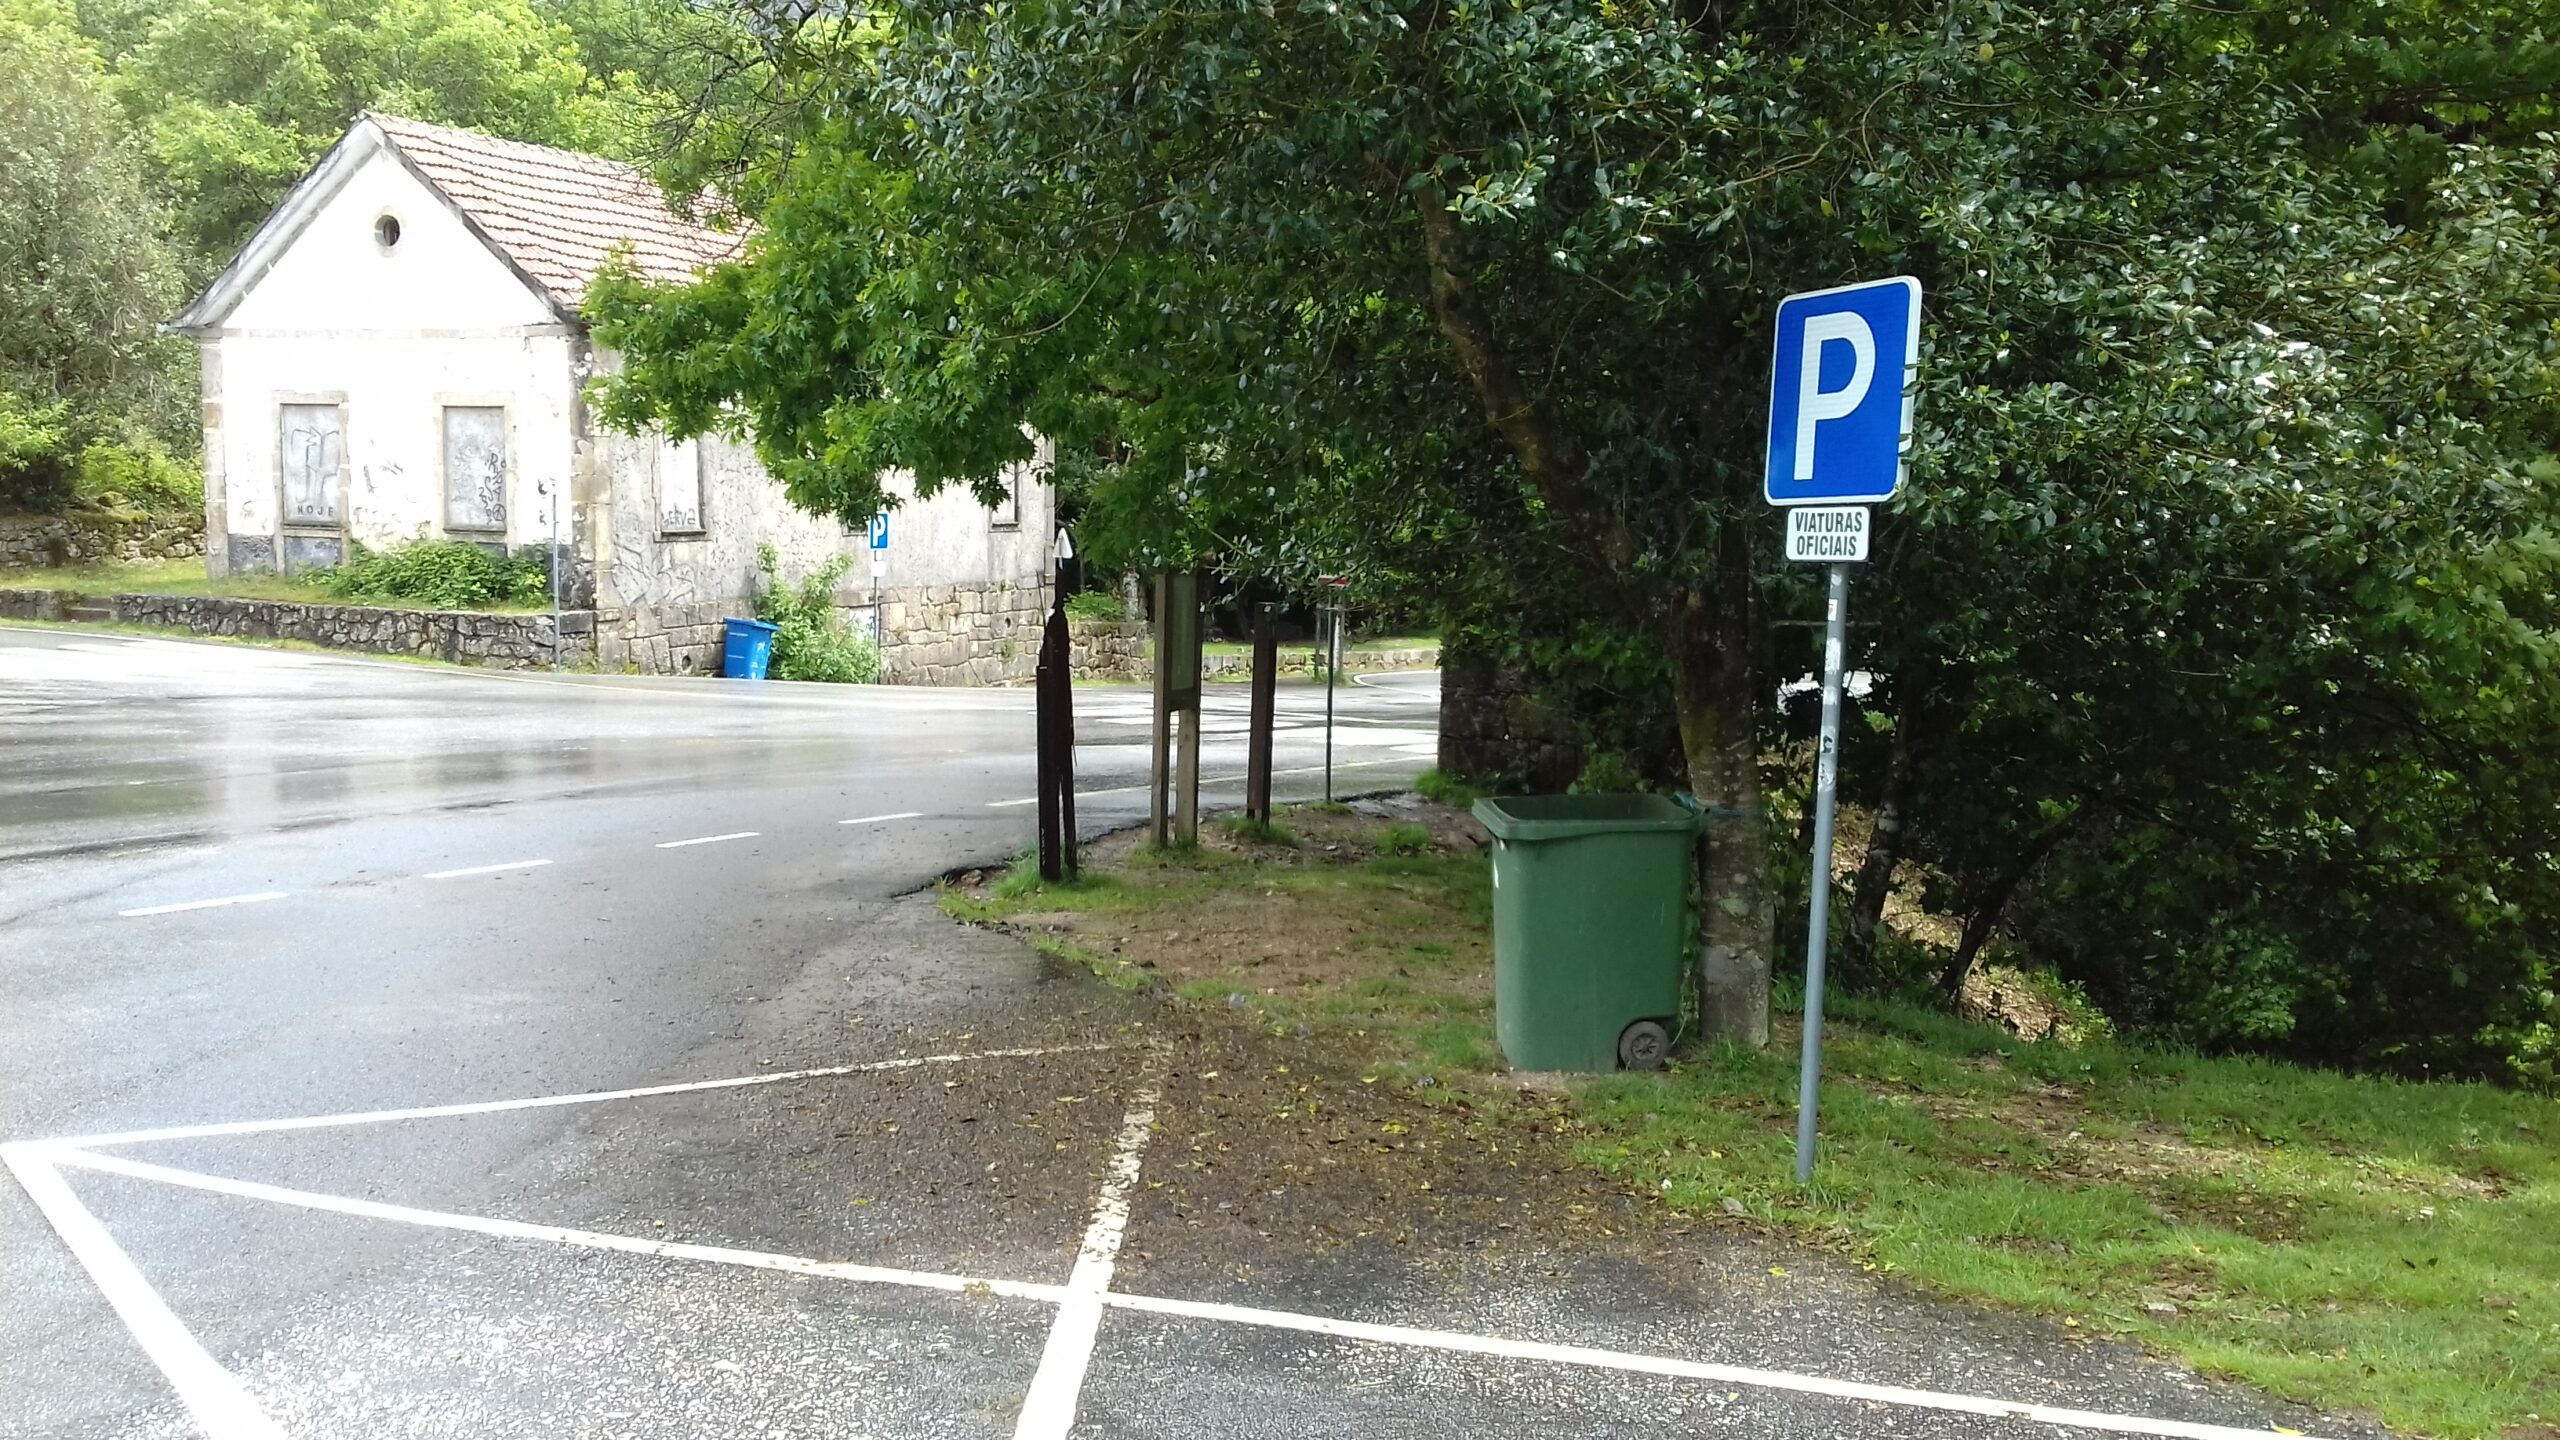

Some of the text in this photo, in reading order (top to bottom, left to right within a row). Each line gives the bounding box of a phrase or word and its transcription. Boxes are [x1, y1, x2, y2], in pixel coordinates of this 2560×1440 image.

[1793, 311, 1876, 481] P
[872, 515, 887, 548] P
[1795, 511, 1863, 533] VIATURAS
[1796, 535, 1857, 557] OFICIAIS
